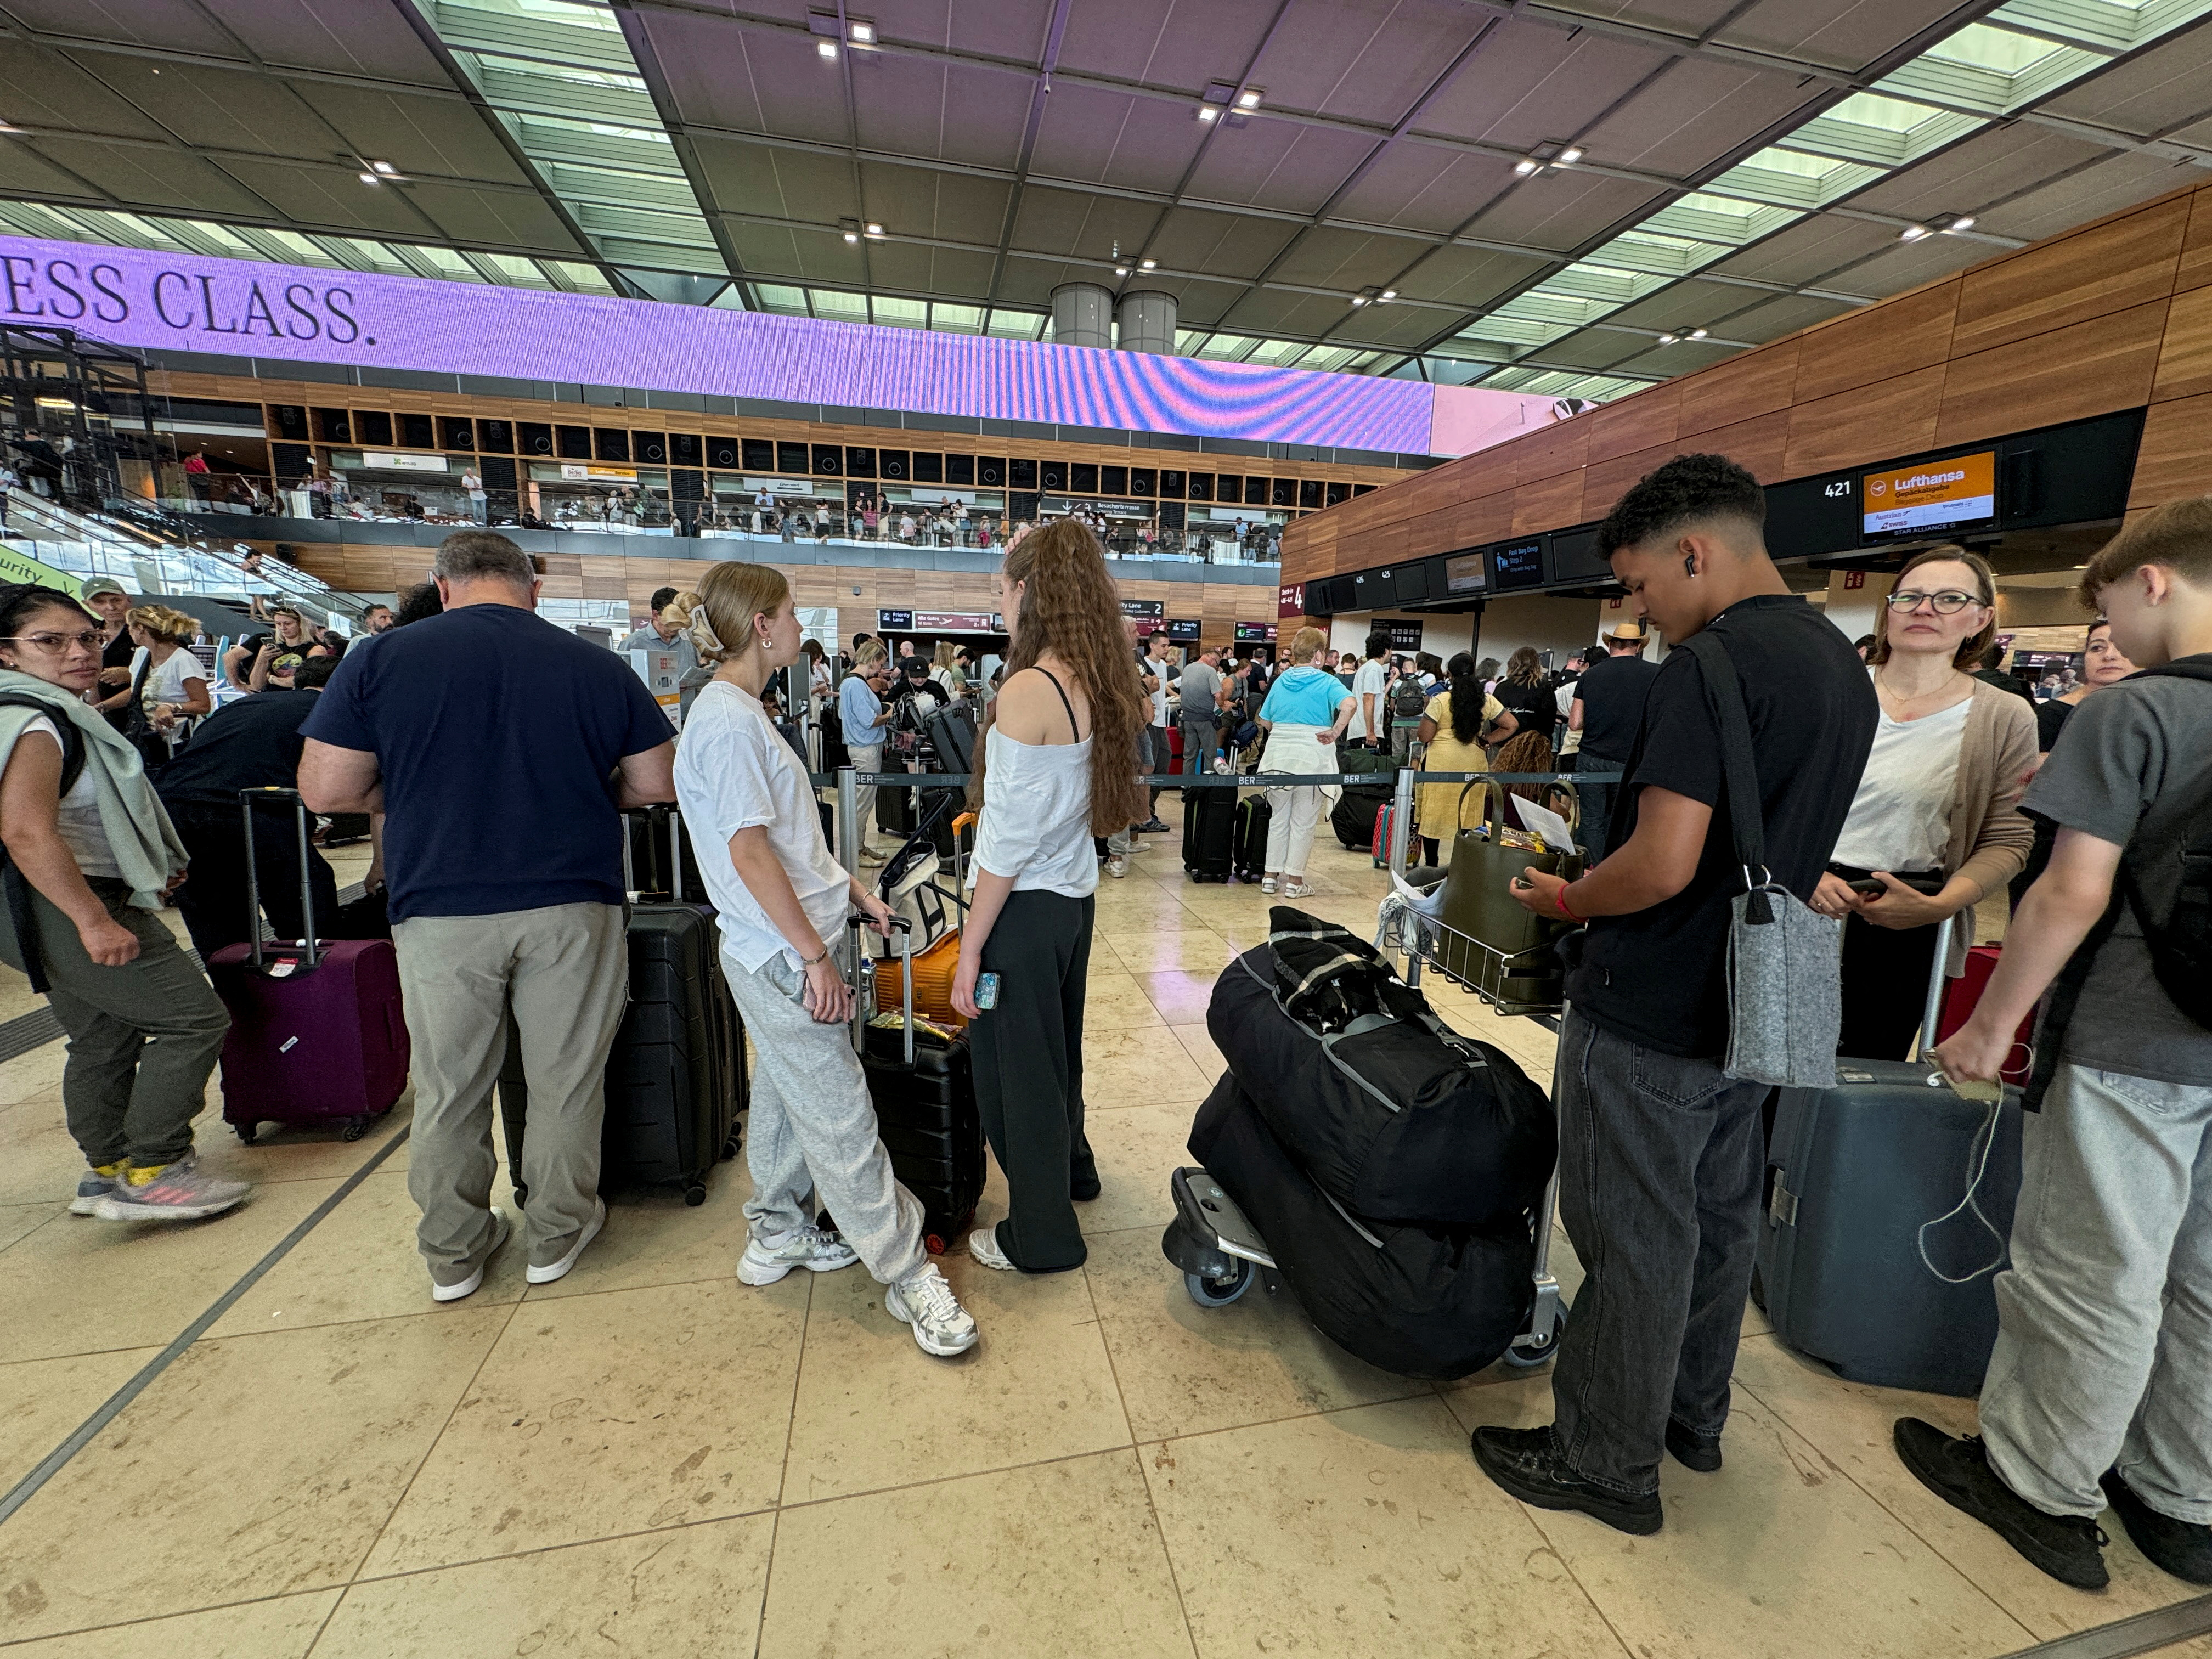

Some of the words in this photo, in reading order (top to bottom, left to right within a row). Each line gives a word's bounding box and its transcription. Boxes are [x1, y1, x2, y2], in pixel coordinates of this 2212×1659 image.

[0, 255, 128, 323] ESS
[153, 271, 376, 346] CLASS.
[1894, 470, 1965, 491] Lufthansa
[1825, 481, 1850, 498] 421
[1875, 512, 1901, 521] Austrian
[1912, 524, 1948, 533] ALLIANCE
[1294, 586, 1302, 609] 4
[1154, 603, 1161, 614] 2
[1238, 776, 1255, 785] BER
[1344, 775, 1360, 783] BER
